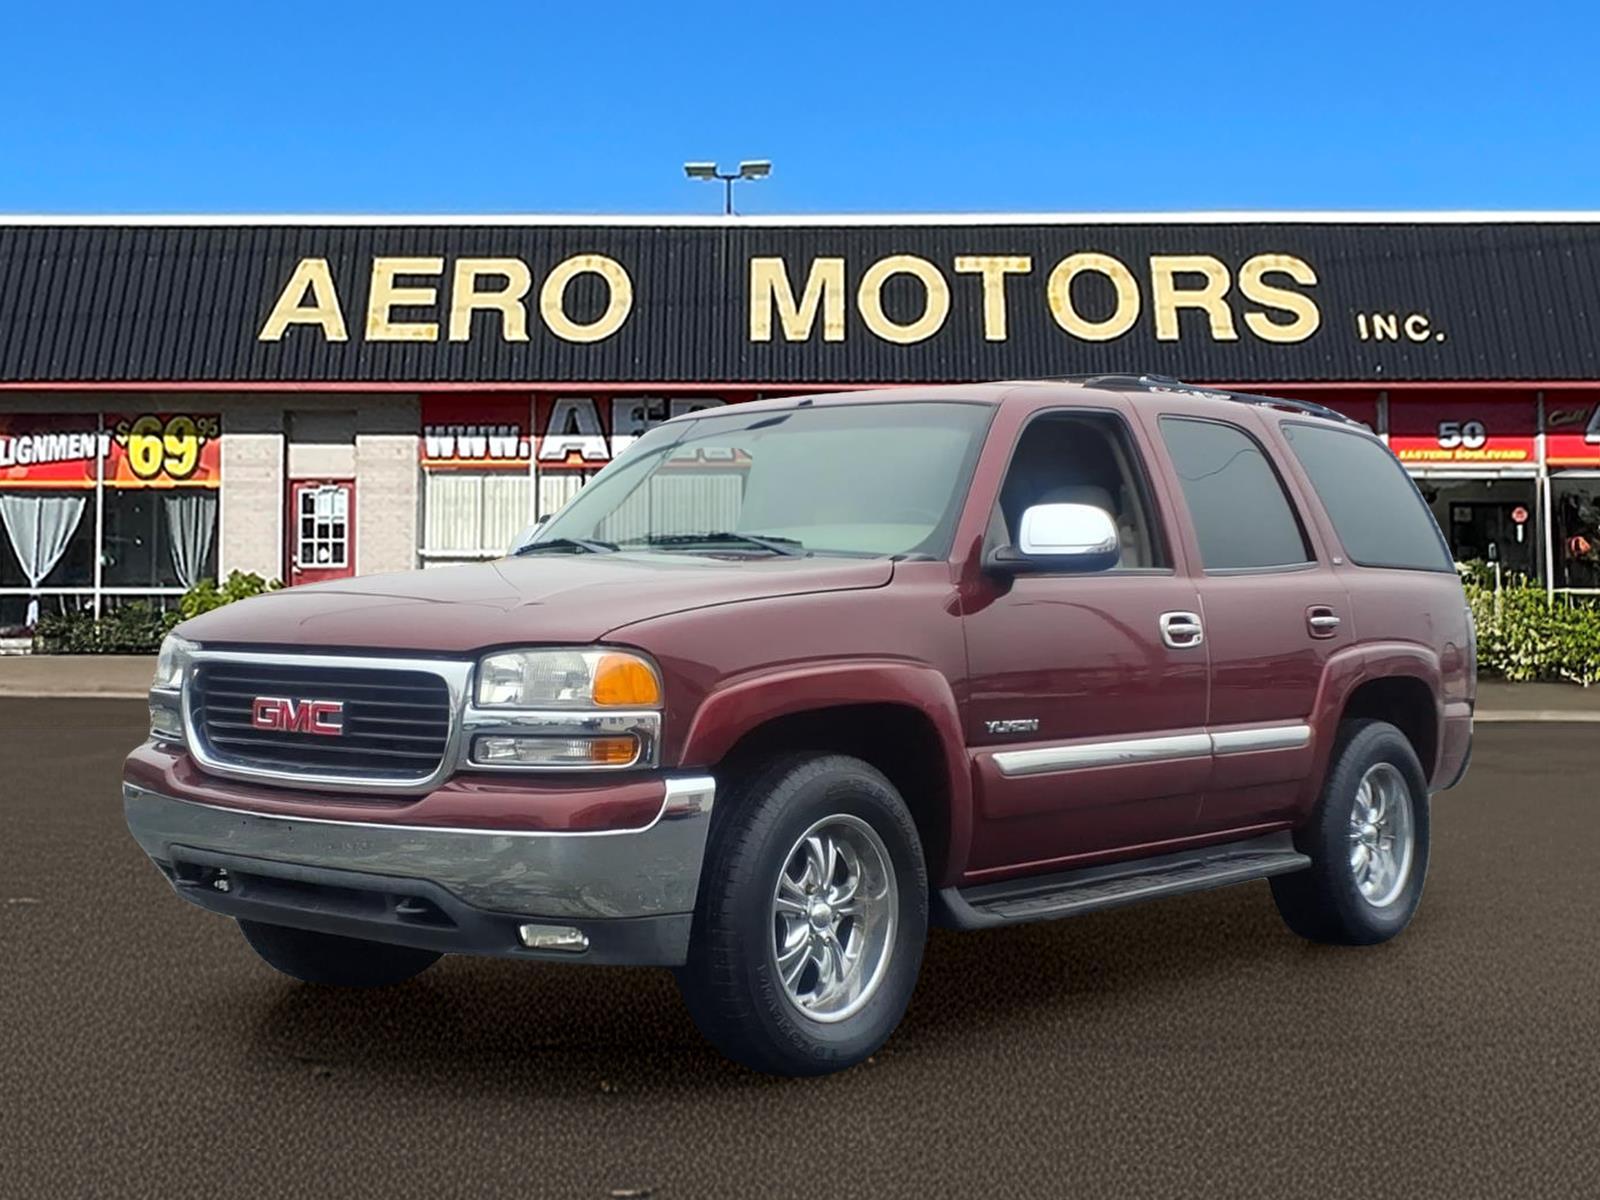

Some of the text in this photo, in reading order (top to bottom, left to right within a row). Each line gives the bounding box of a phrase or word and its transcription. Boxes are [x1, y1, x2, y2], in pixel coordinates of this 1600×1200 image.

[258, 253, 1446, 344] AERO MOTORS INC.
[1438, 421, 1486, 449] 50
[252, 697, 344, 735] GMC
